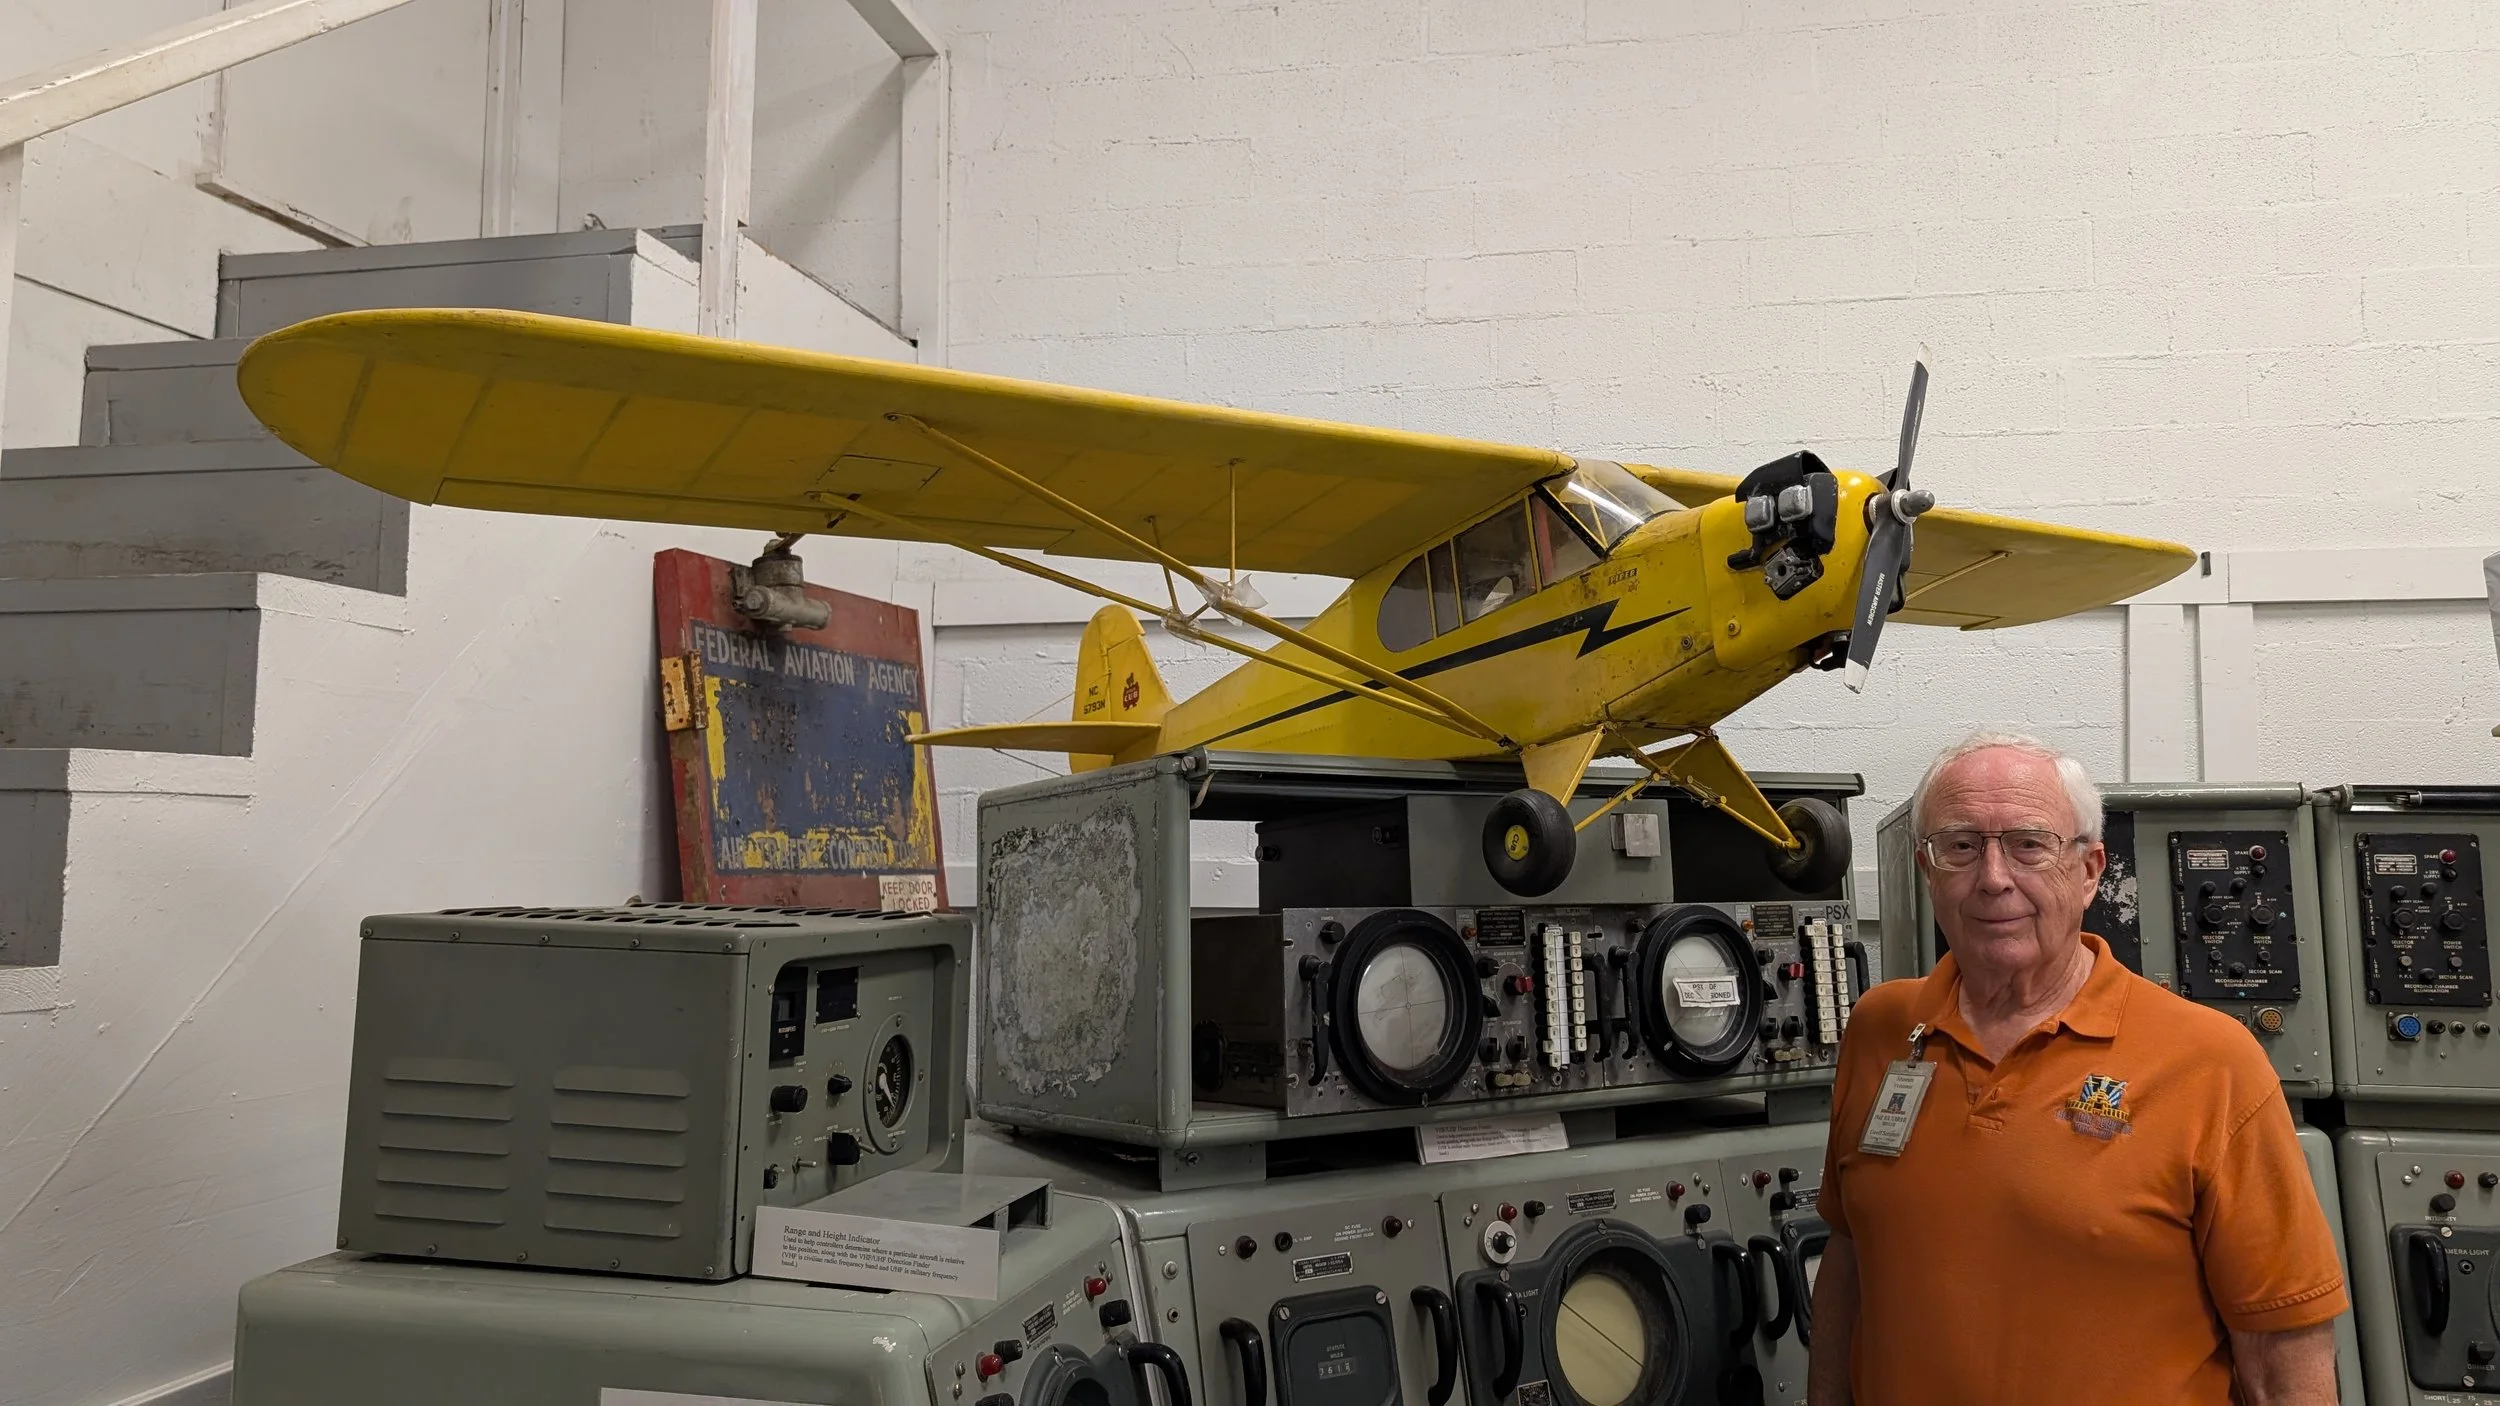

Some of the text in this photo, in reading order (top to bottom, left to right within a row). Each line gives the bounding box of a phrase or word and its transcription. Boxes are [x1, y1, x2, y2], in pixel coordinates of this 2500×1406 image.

[1867, 572, 1885, 627] MASTER AIRSCREW
[694, 625, 919, 699] FEDERAL AVIATION AGENCY
[1088, 685, 1099, 697] NC
[1124, 690, 1138, 702] CUB
[1511, 833, 1520, 851] CUB
[881, 880, 933, 895] KEEP DOOR
[891, 897, 930, 912] LOCKED
[1825, 904, 1851, 920] PSX
[784, 1225, 881, 1245] Range and Height Indicator
[783, 1235, 797, 1243] Used
[804, 1238, 816, 1247] help
[816, 1240, 844, 1250] controllers
[844, 1244, 871, 1253] determine
[871, 1247, 888, 1255] where
[893, 1250, 919, 1260] particular
[919, 1254, 938, 1262] aircraft
[945, 1256, 965, 1265] relative
[788, 1244, 797, 1252] his
[797, 1246, 820, 1256] position,
[820, 1249, 836, 1258] along
[849, 1252, 858, 1260] the
[859, 1253, 886, 1263] VHF/UHF
[887, 1257, 913, 1267] Direction
[912, 1260, 931, 1269] Finder
[781, 1251, 797, 1260] (VHF
[804, 1255, 823, 1263] civilian
[823, 1257, 838, 1265] radio
[838, 1259, 864, 1269] frequency
[865, 1262, 879, 1270] band
[879, 1264, 889, 1272] and
[890, 1265, 904, 1274] UHF
[910, 1269, 931, 1278] military
[931, 1271, 959, 1281] frequency
